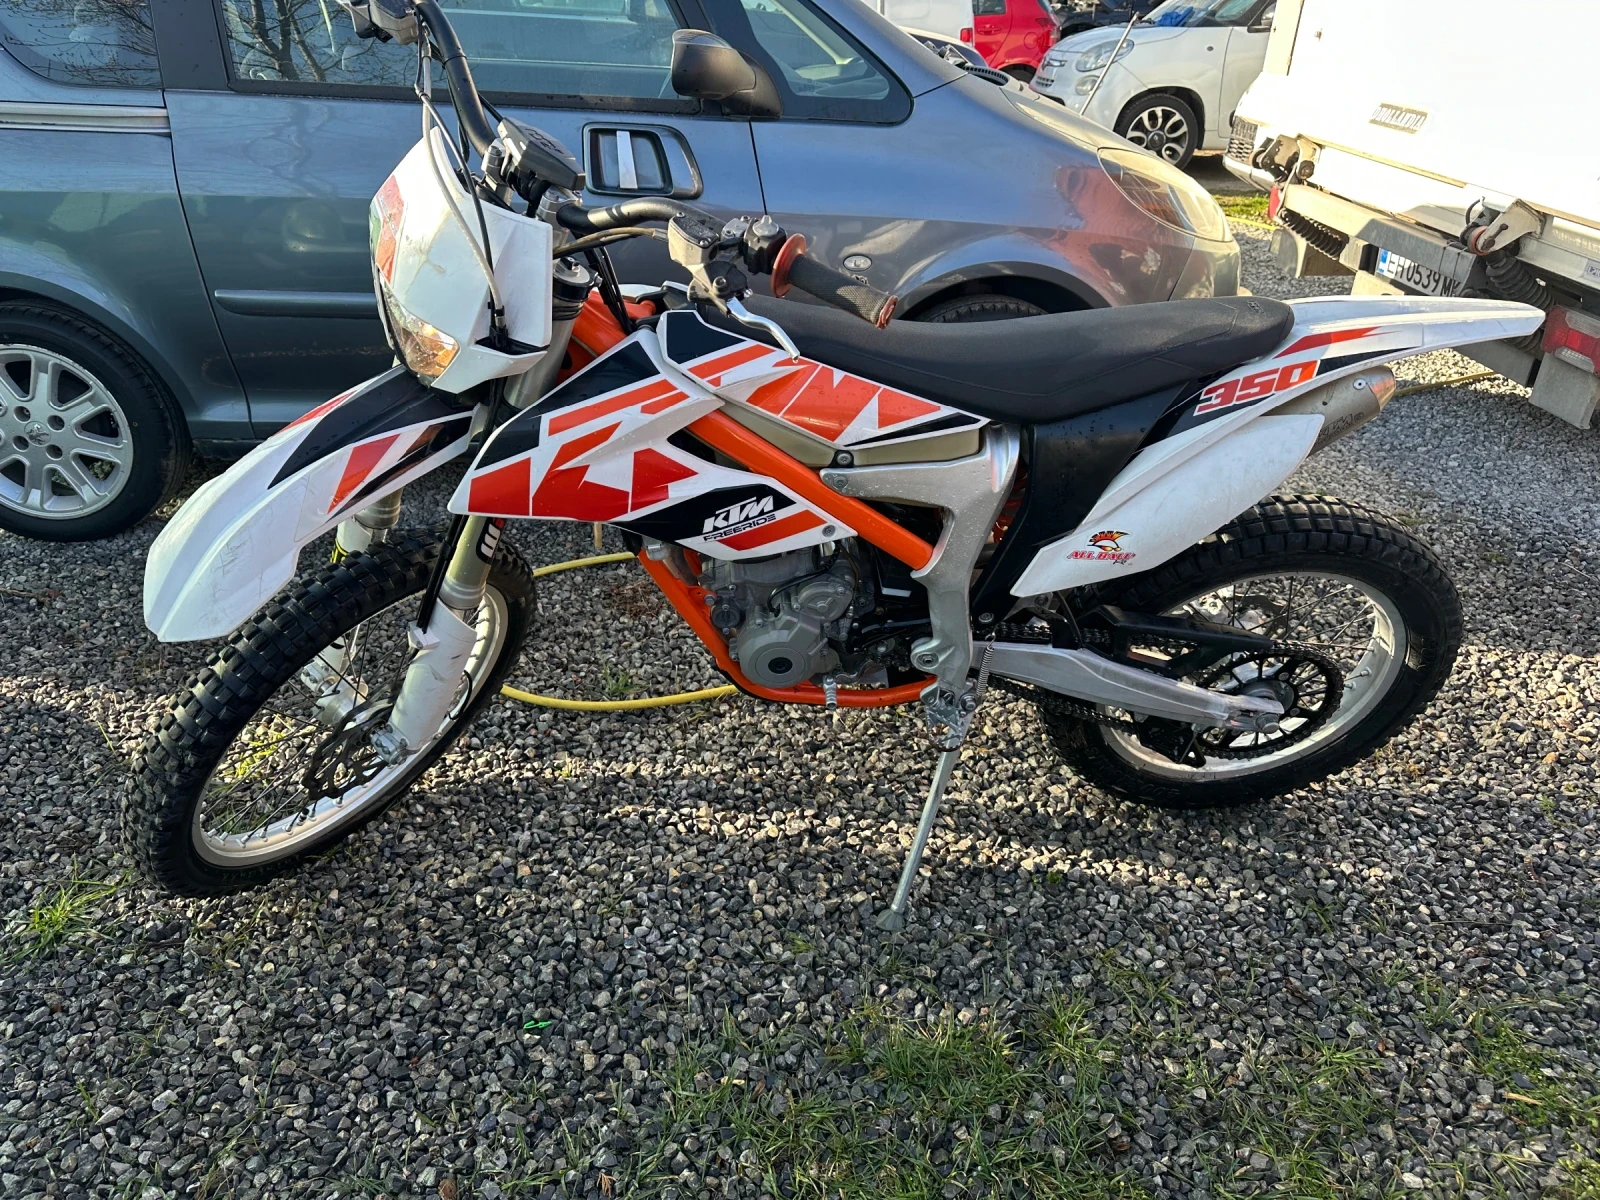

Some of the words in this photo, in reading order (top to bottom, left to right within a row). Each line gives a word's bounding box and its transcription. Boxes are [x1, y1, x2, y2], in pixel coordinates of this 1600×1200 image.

[1193, 359, 1321, 416] 350
[702, 495, 774, 534] KTM
[703, 513, 777, 541] FREERIDE
[1066, 550, 1095, 560] ALL
